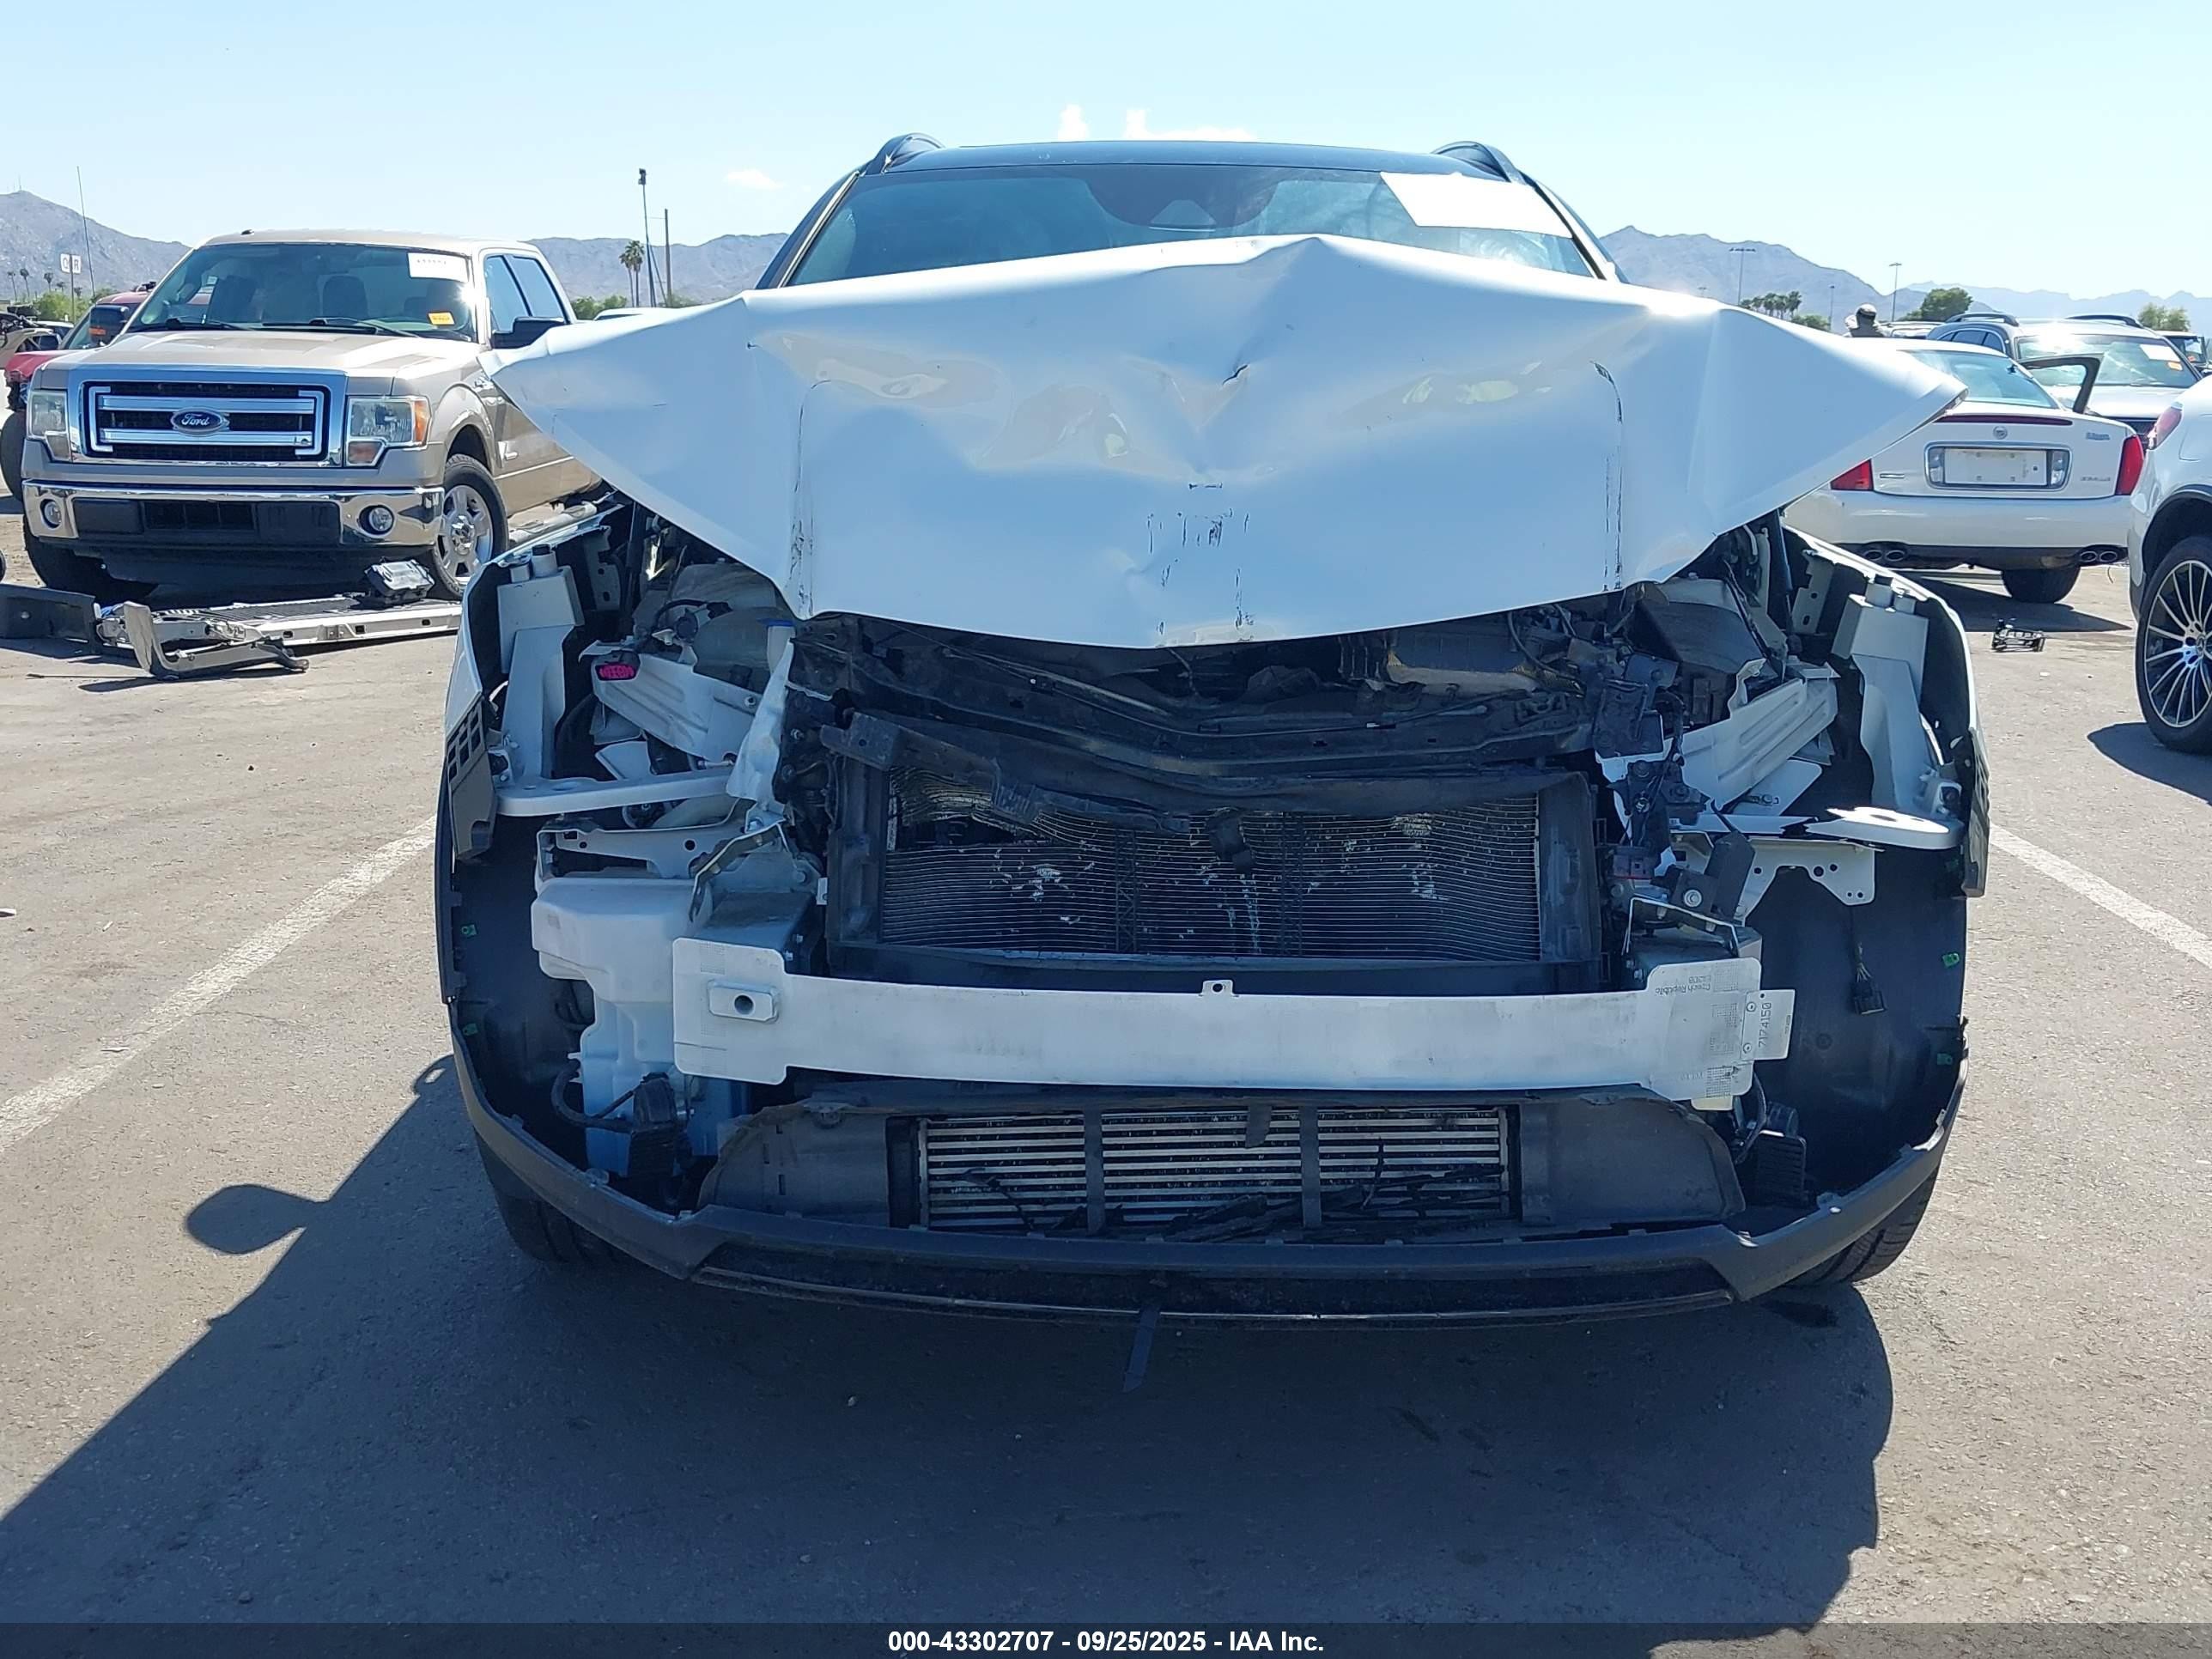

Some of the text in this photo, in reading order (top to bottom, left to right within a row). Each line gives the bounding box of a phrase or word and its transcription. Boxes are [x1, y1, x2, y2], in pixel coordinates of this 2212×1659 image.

[73, 258, 80, 270] R
[181, 413, 210, 426] Ford
[1758, 1002, 1771, 1048] 7174150
